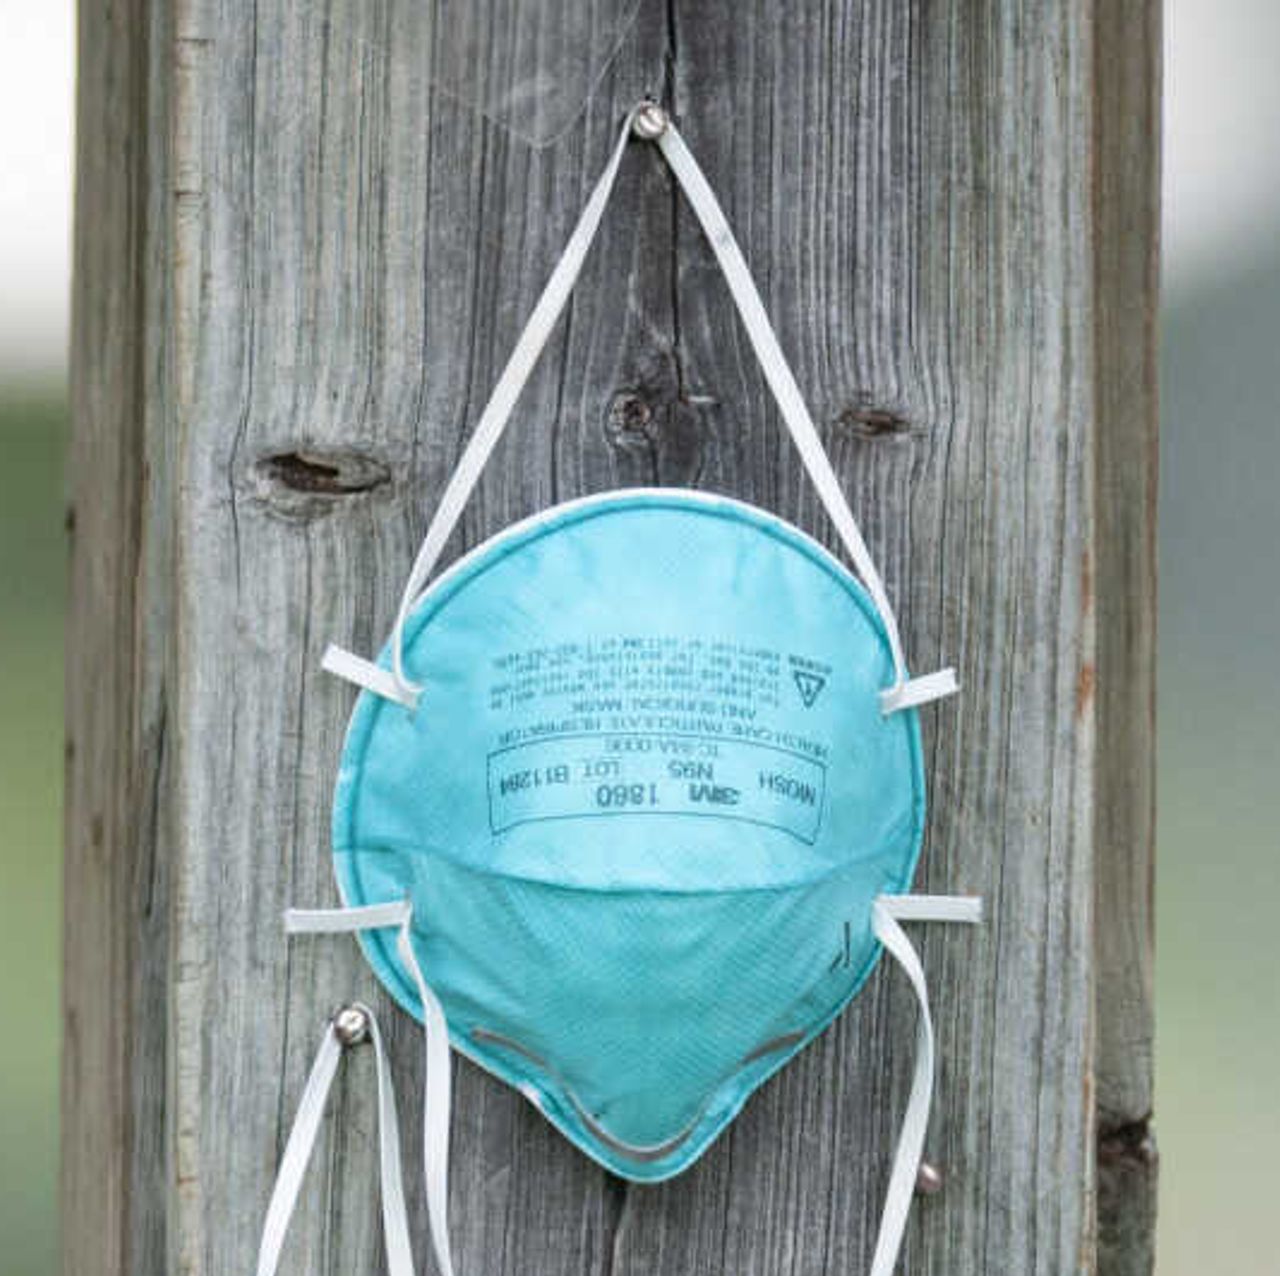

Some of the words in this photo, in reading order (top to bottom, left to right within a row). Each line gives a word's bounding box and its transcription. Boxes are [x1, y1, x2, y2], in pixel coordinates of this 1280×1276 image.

[582, 760, 621, 778] LOT
[667, 761, 714, 782] N95
[595, 784, 660, 809] 1860
[689, 784, 742, 806] 3M
[758, 771, 816, 807] NIOSH
